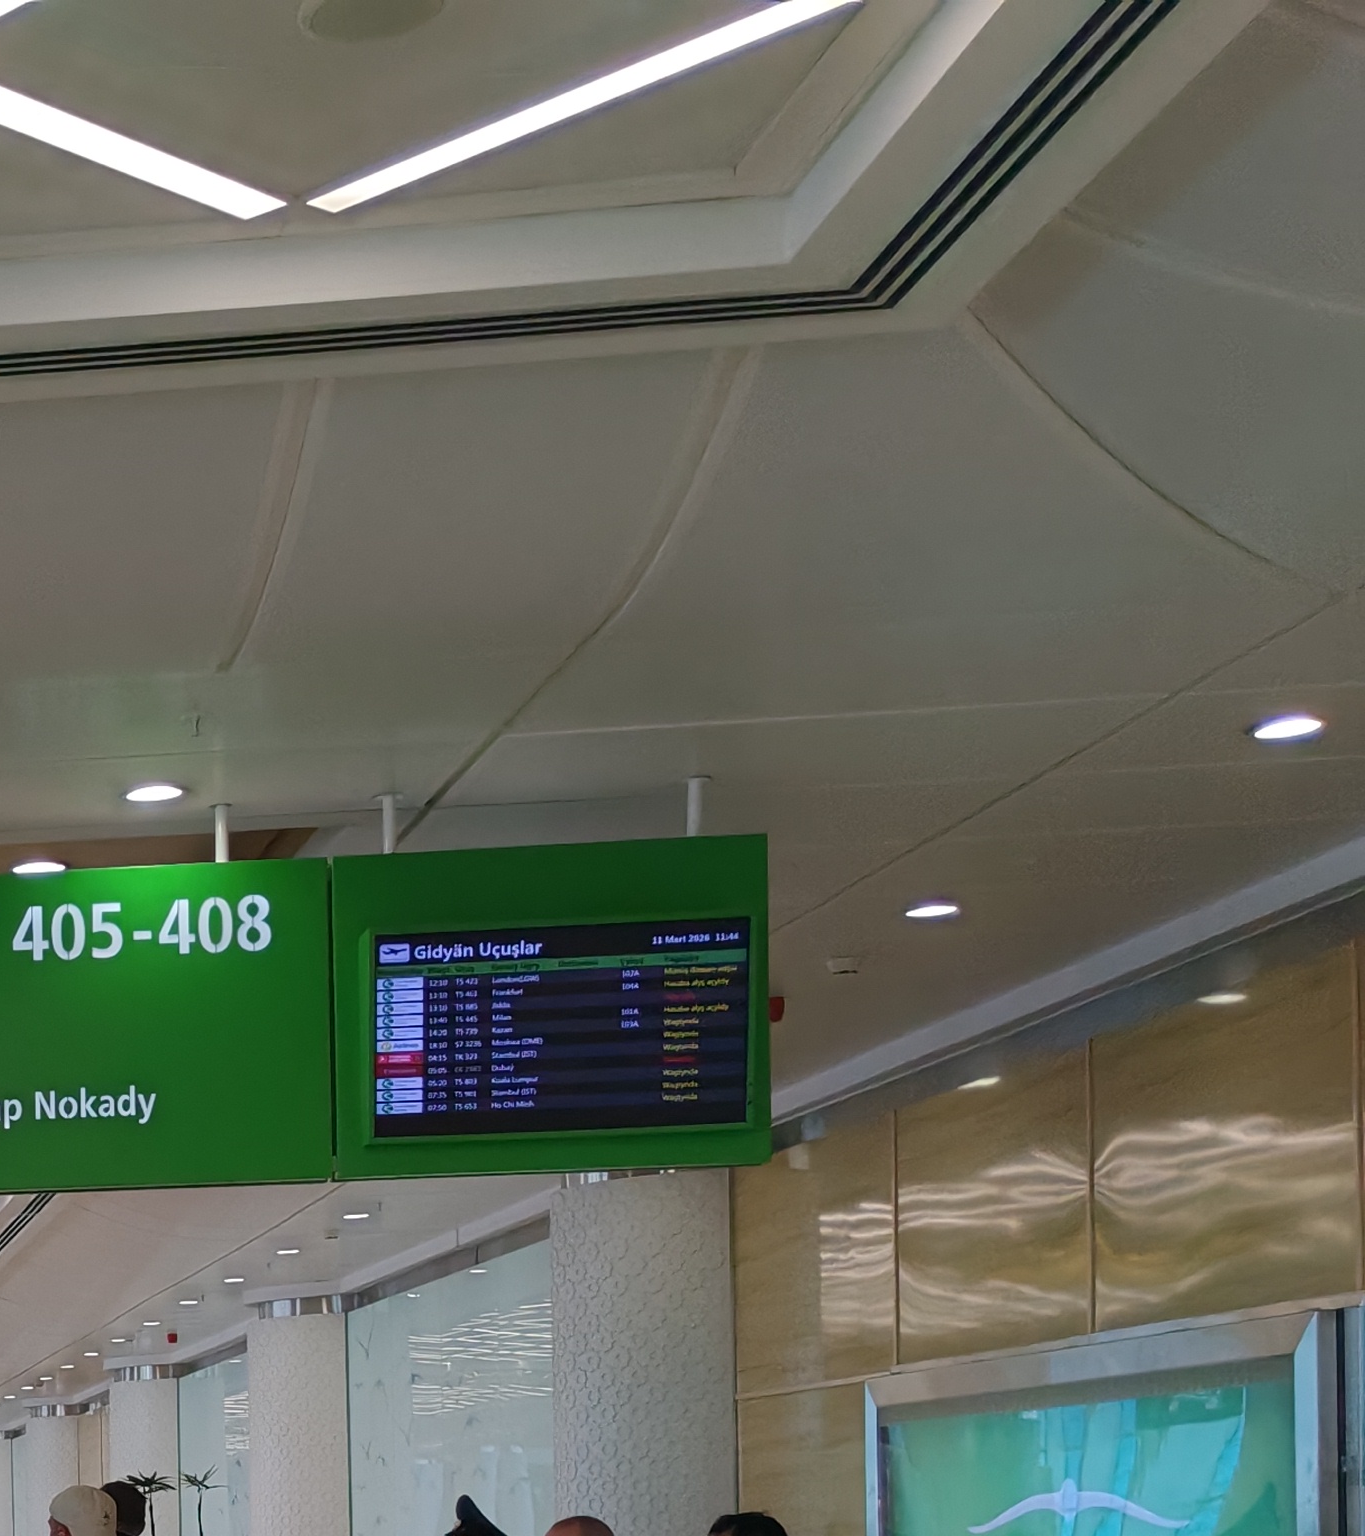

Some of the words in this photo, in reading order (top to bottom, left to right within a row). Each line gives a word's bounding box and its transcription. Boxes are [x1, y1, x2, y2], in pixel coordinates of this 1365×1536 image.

[13, 895, 271, 960] 405-408
[480, 940, 542, 958] Uçuşlar
[35, 1086, 155, 1124] Nokady
